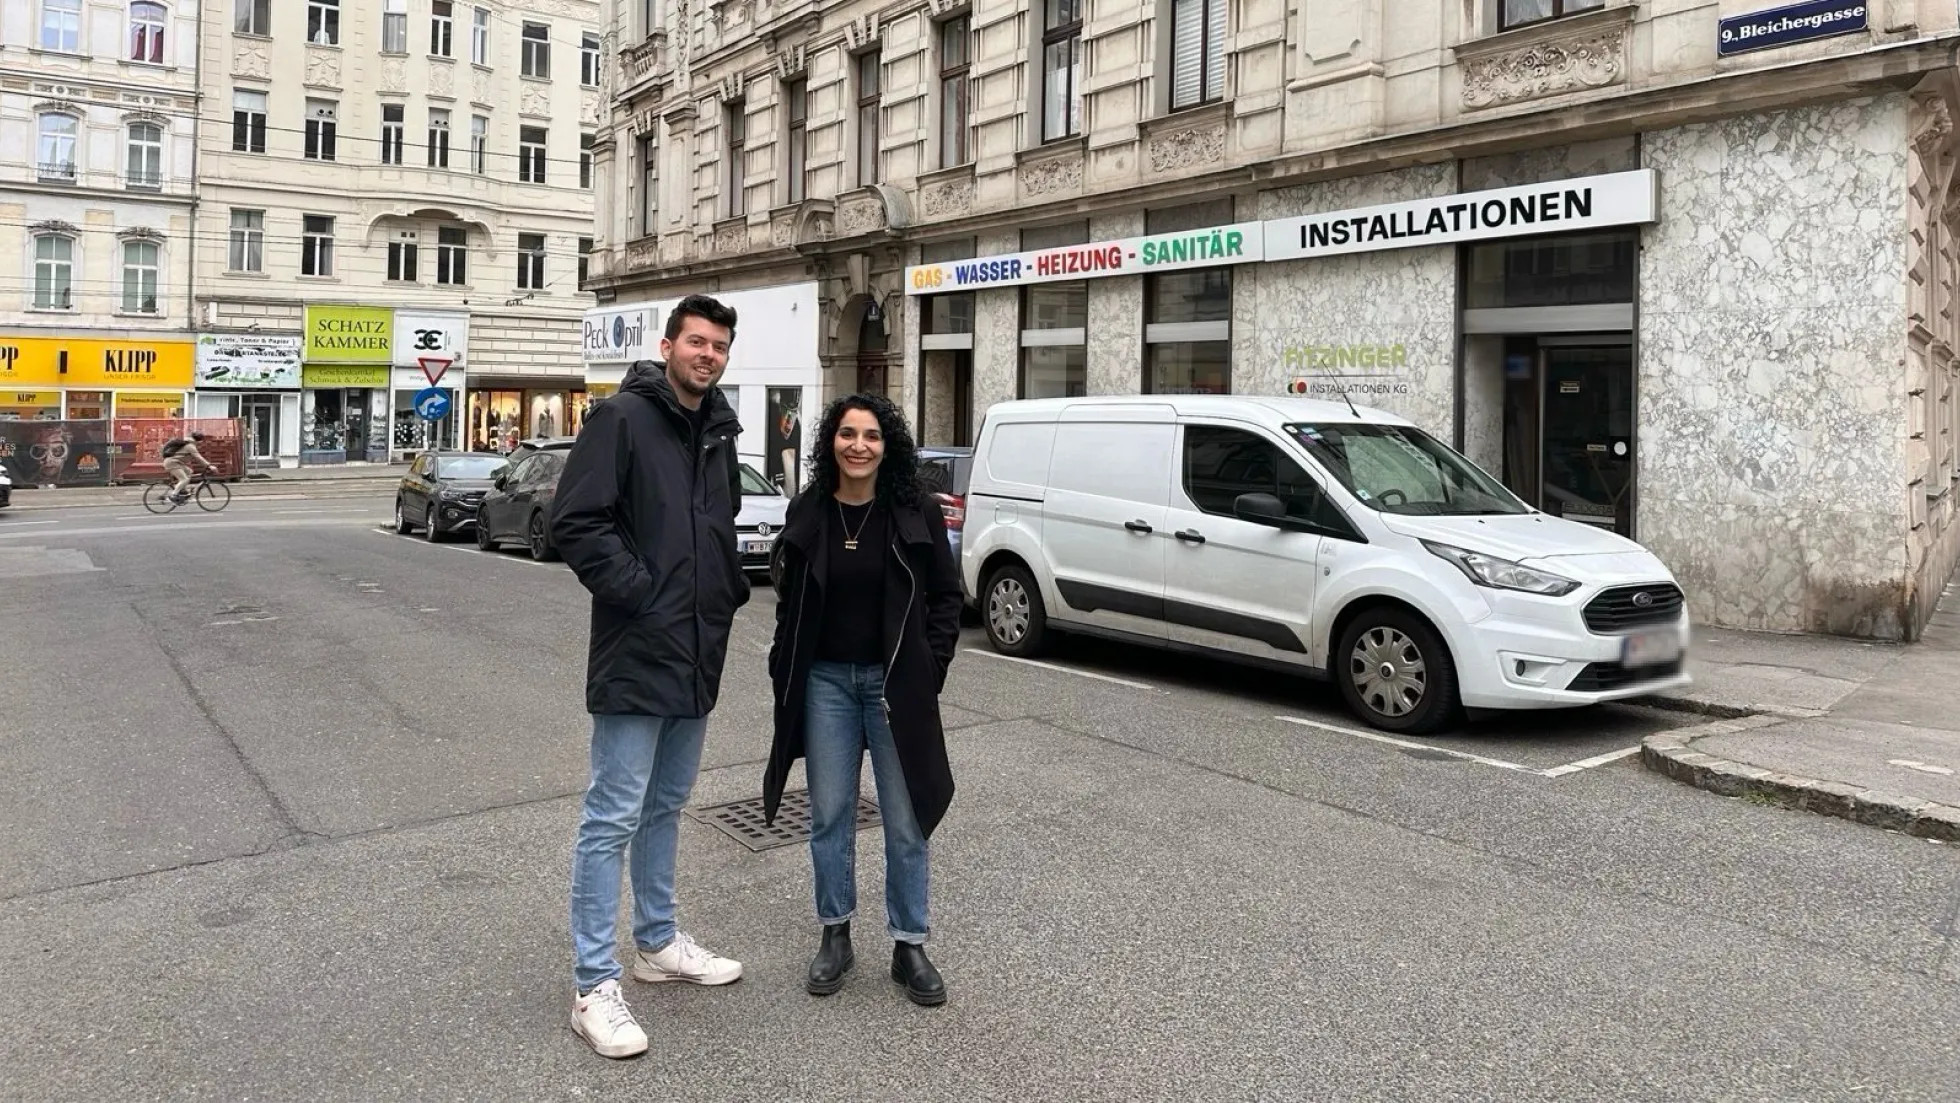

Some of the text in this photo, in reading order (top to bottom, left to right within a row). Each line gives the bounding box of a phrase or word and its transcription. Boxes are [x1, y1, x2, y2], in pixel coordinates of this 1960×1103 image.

[1739, 5, 1866, 39] Bleichergasse
[912, 267, 943, 289] GAS
[955, 259, 1021, 285] WASSER
[1037, 246, 1122, 276] HEIZUNG
[1142, 229, 1244, 265] SANITÄR
[1300, 187, 1593, 249] INSTALLATIONEN
[318, 319, 385, 333] SCHATZ
[314, 335, 389, 349] KAMMER
[105, 349, 157, 373] KLIPP
[1285, 344, 1406, 368] FITZINGER
[1310, 384, 1408, 394] INSTALLATIONEN KG
